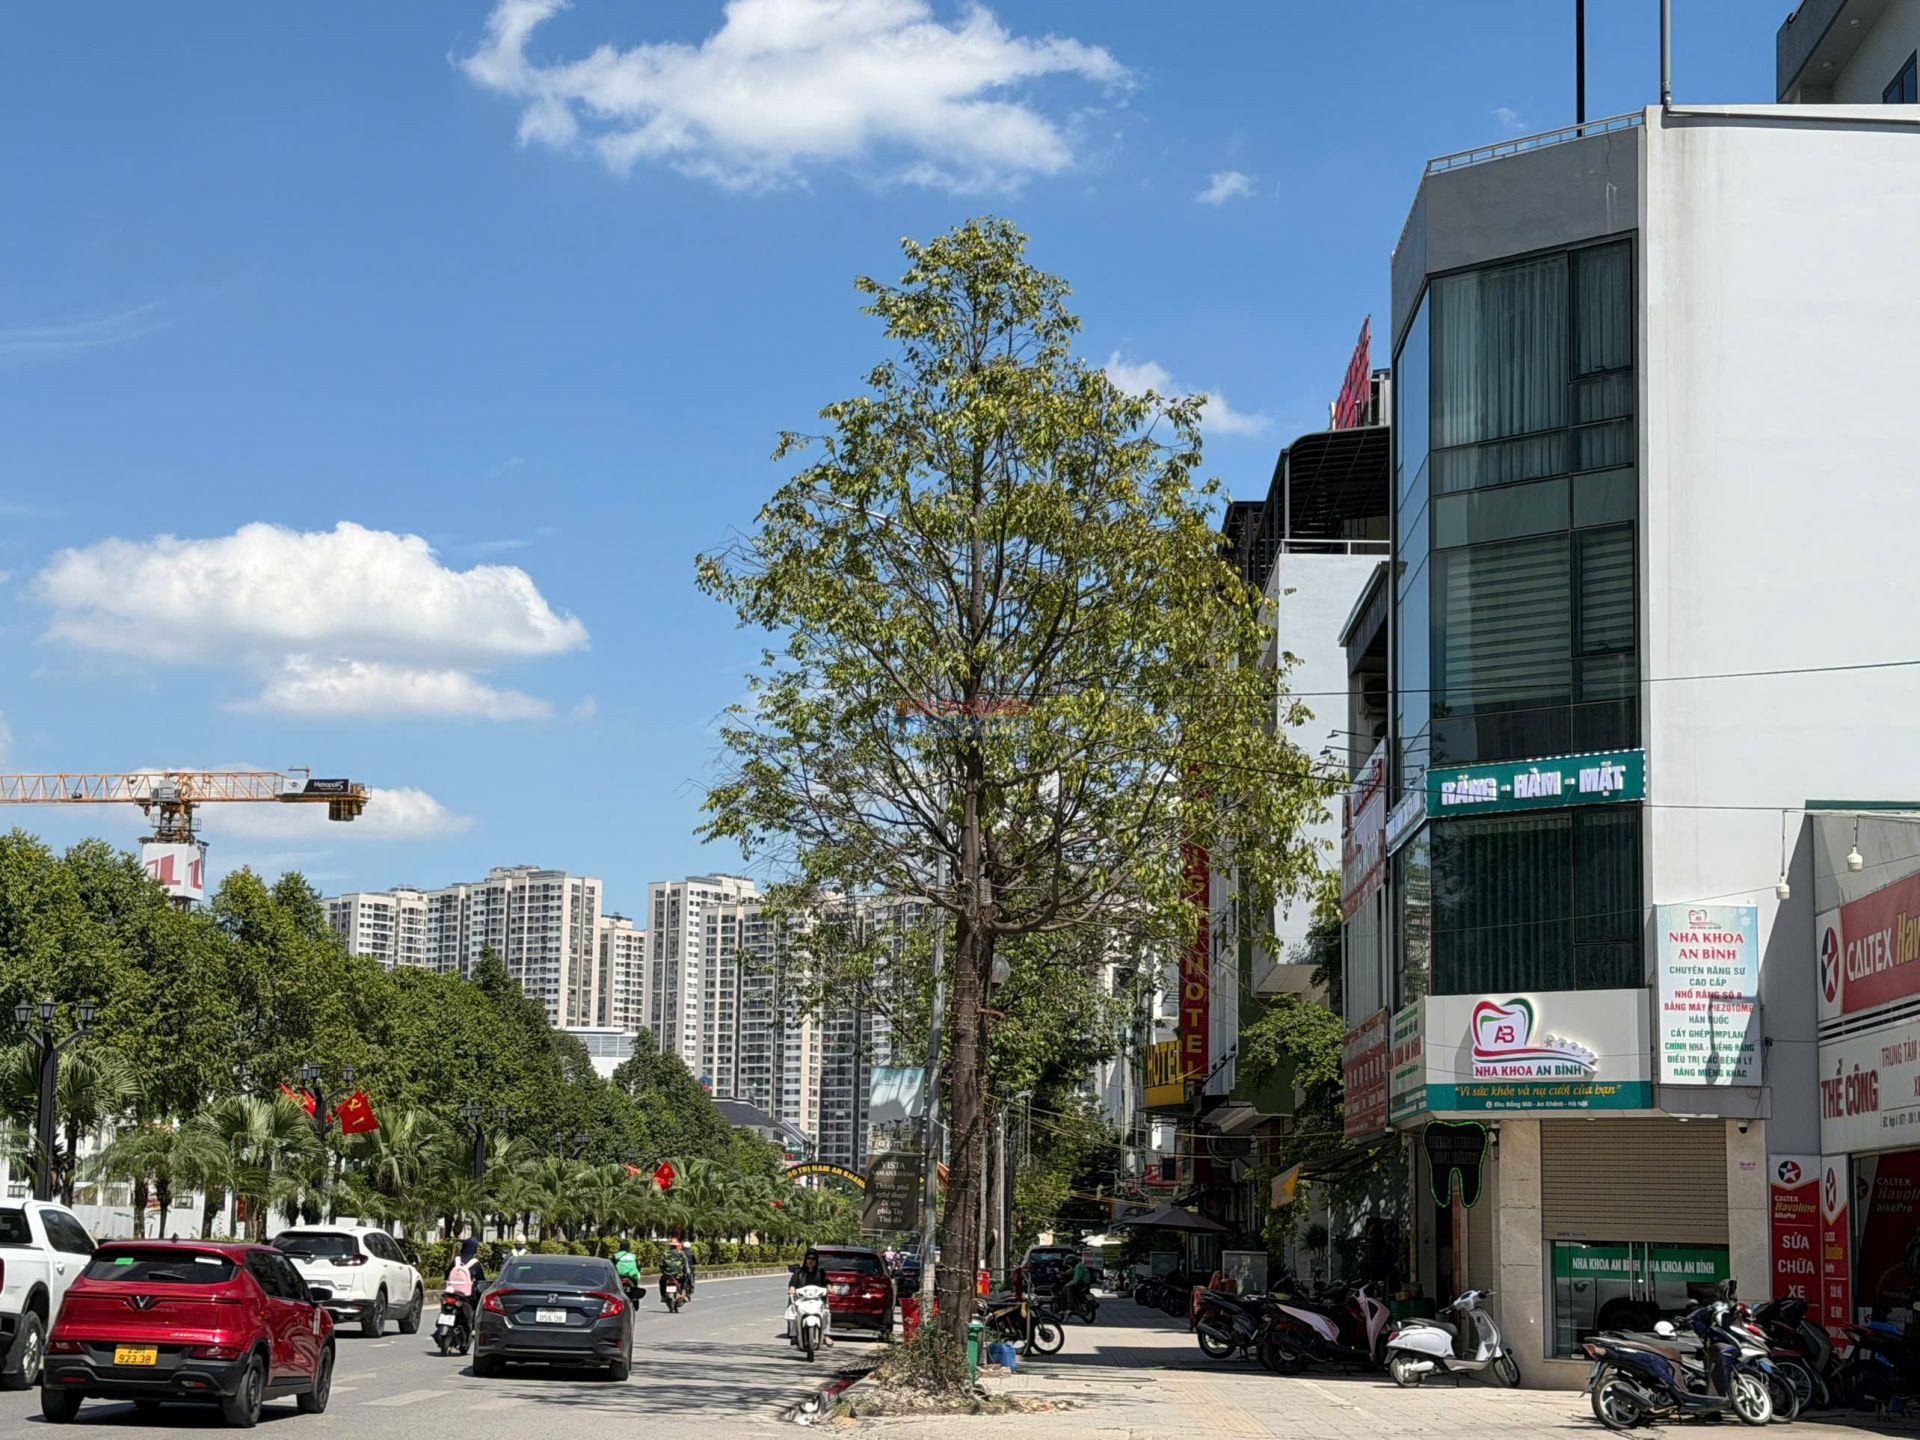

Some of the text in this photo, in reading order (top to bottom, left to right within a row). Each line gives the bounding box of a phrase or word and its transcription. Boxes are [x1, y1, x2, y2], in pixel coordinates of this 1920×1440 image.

[1441, 774, 1497, 806] RĂNG
[1514, 767, 1561, 798] HÀM
[1579, 761, 1626, 796] MẶT
[1669, 932, 1744, 944] NHA KHOA
[1679, 946, 1736, 960] AN BÌNH
[1847, 928, 1893, 981] CALTEX
[1689, 978, 1706, 987] CAO
[1689, 1002, 1706, 1012] MÁY
[1494, 1026, 1515, 1043] AB
[1689, 1028, 1710, 1038] GHÉP
[1689, 1042, 1705, 1051] NHA
[1882, 1036, 1917, 1068] TRUNG TÂM
[1475, 1063, 1581, 1076] NHA KHOA AN BÌNH
[1517, 1086, 1530, 1096] và
[1845, 1063, 1878, 1117] CÔNG
[882, 1161, 905, 1170] VISTA
[1876, 1177, 1911, 1186] CALTEX
[1775, 1201, 1816, 1213] Havoline
[1877, 1203, 1912, 1213] bikePro
[1572, 1258, 1587, 1269] NHA
[1589, 1258, 1609, 1270] KHOA
[1611, 1259, 1621, 1270] AN
[1661, 1261, 1682, 1273] KHOA
[1683, 1261, 1695, 1273] AN
[1696, 1259, 1714, 1274] BÌNH
[1778, 1258, 1815, 1275] CHỮA
[1788, 1285, 1805, 1299] XE
